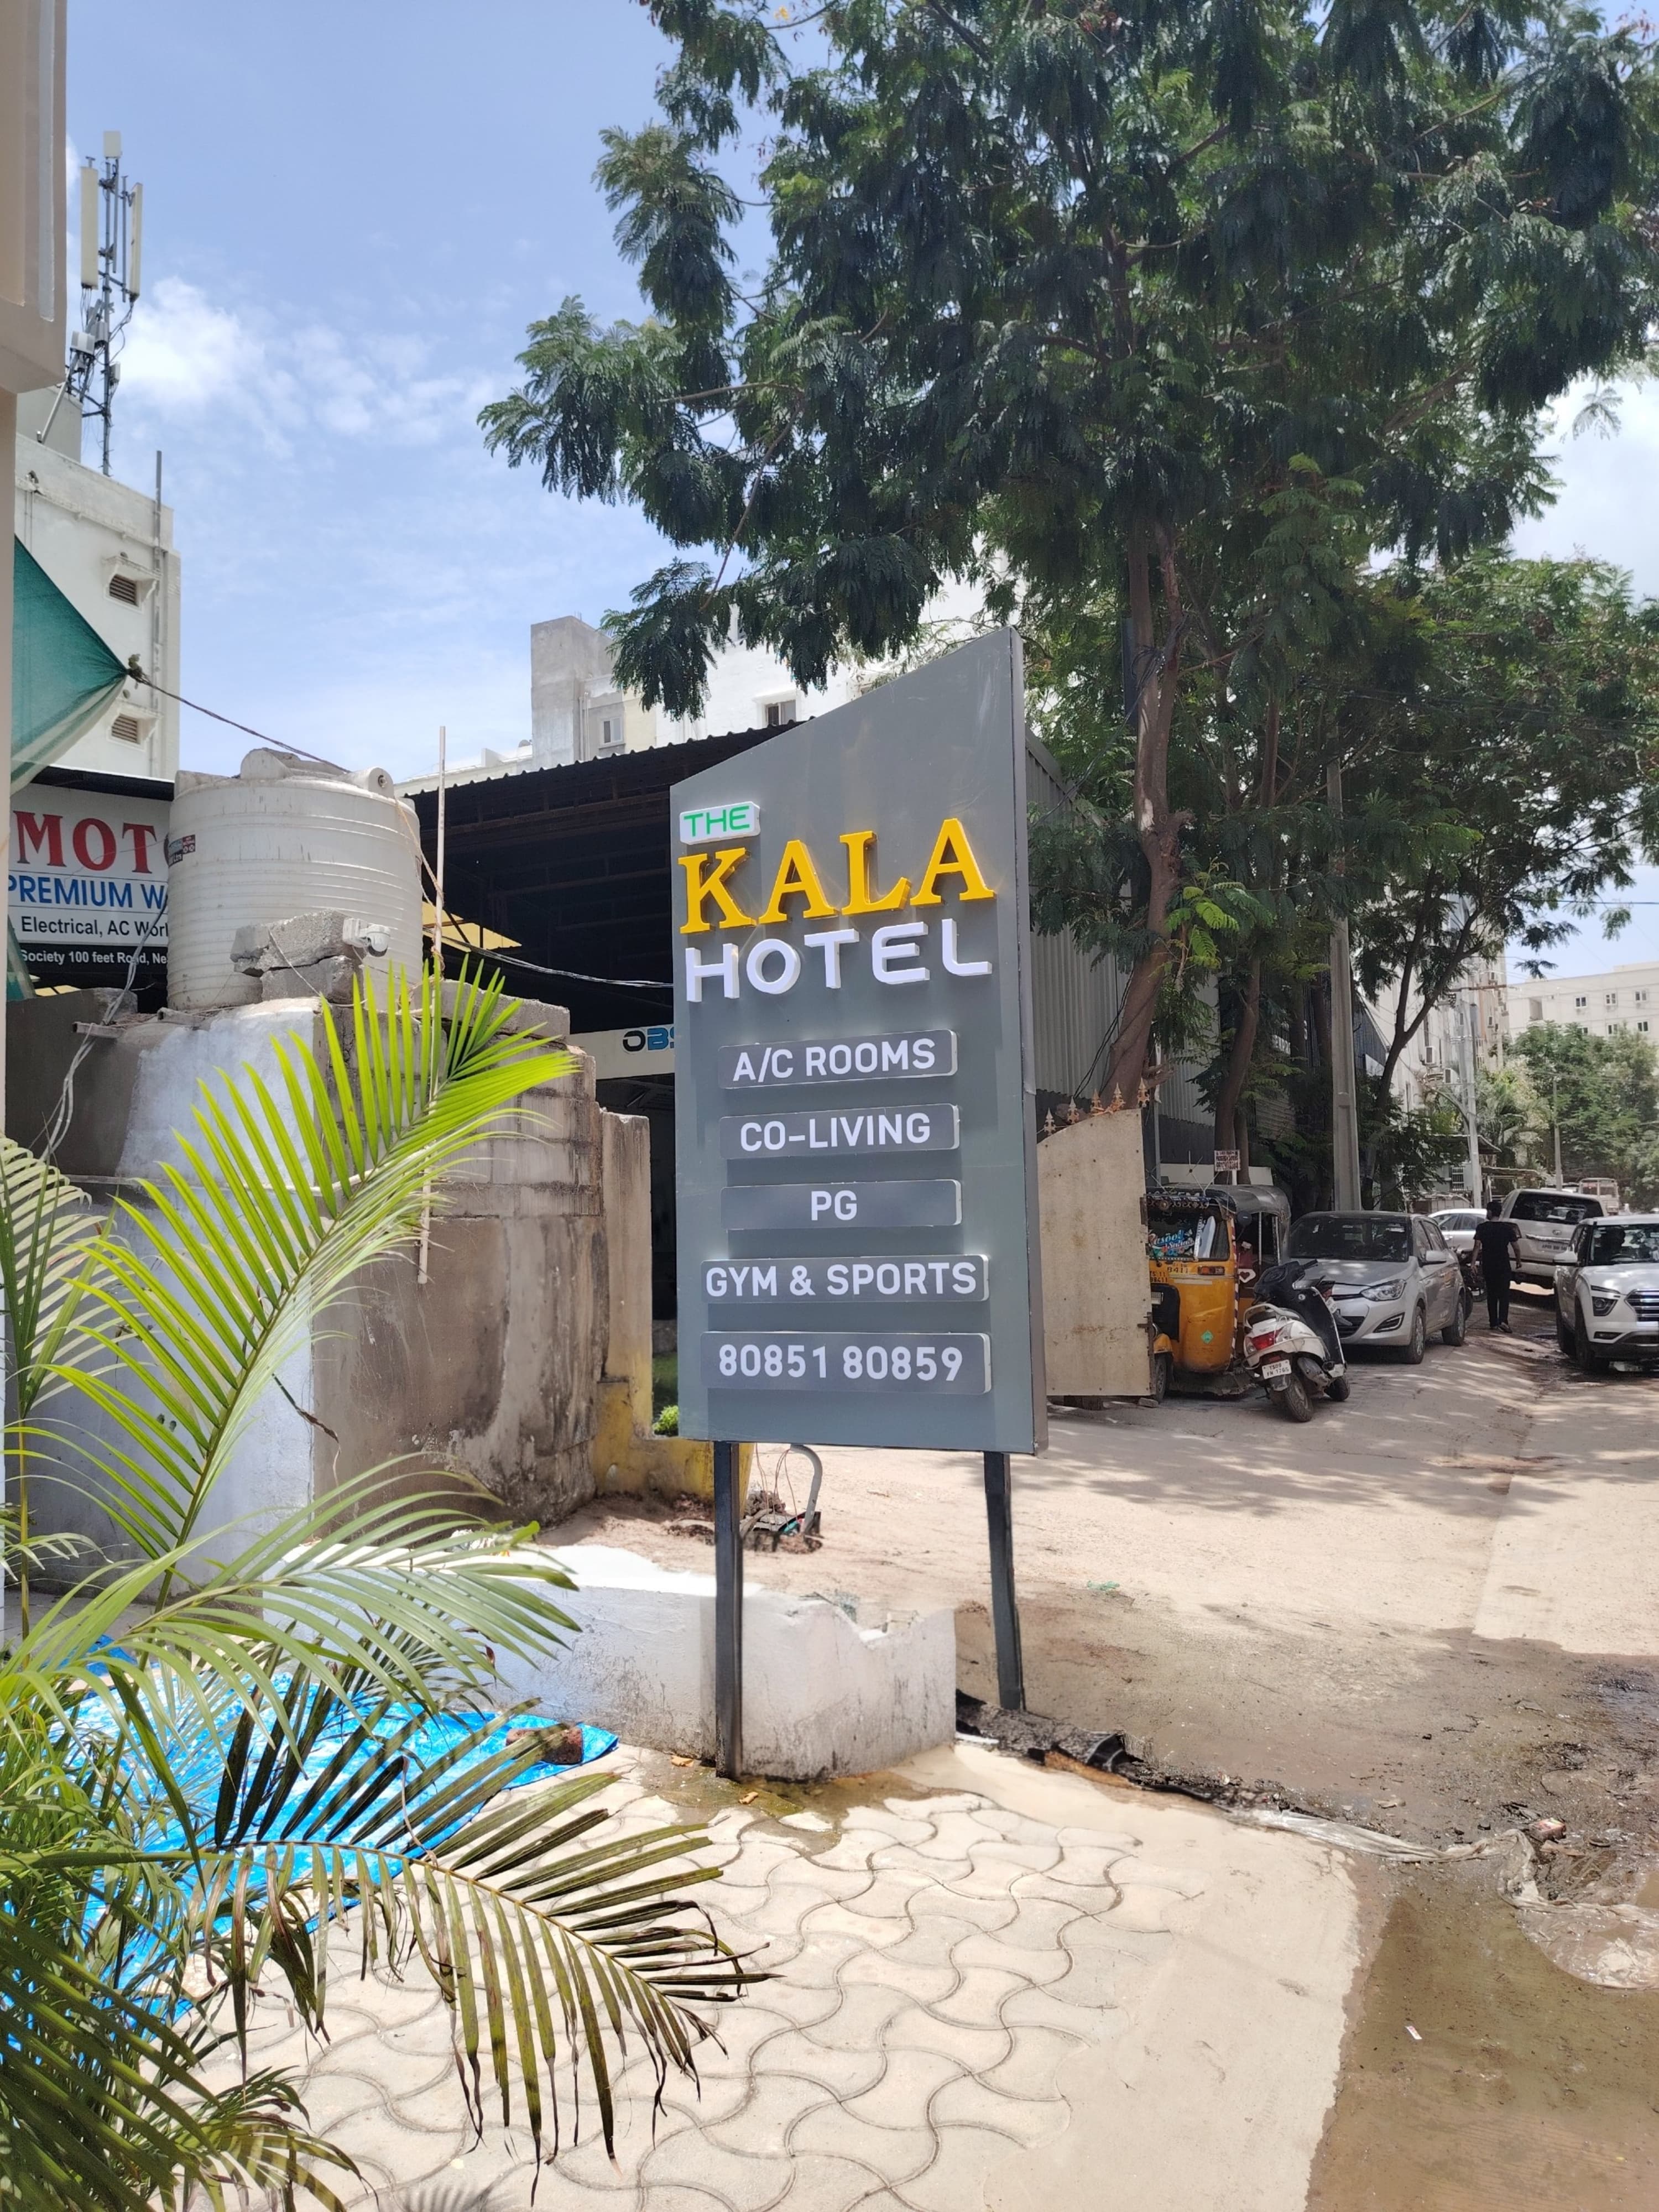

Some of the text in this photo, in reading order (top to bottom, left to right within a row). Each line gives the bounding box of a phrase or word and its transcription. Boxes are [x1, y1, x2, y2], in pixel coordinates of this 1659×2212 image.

[684, 806, 750, 837] THE
[13, 810, 168, 874] MOT
[678, 818, 997, 933] KALA
[22, 916, 103, 937] Electrical,
[107, 920, 130, 936] AC
[22, 950, 65, 966] Society
[69, 951, 89, 963] 100
[92, 951, 115, 963] feet
[153, 952, 168, 964] Ne
[685, 918, 992, 1003] HOTEL
[623, 1026, 674, 1052] OB
[733, 1038, 936, 1082] A/C ROOMS
[740, 1113, 931, 1151] CO-LIVING
[811, 1190, 858, 1220] PG
[706, 1262, 977, 1296] GYM & SPORTS
[719, 1344, 963, 1381] 80851 80859
